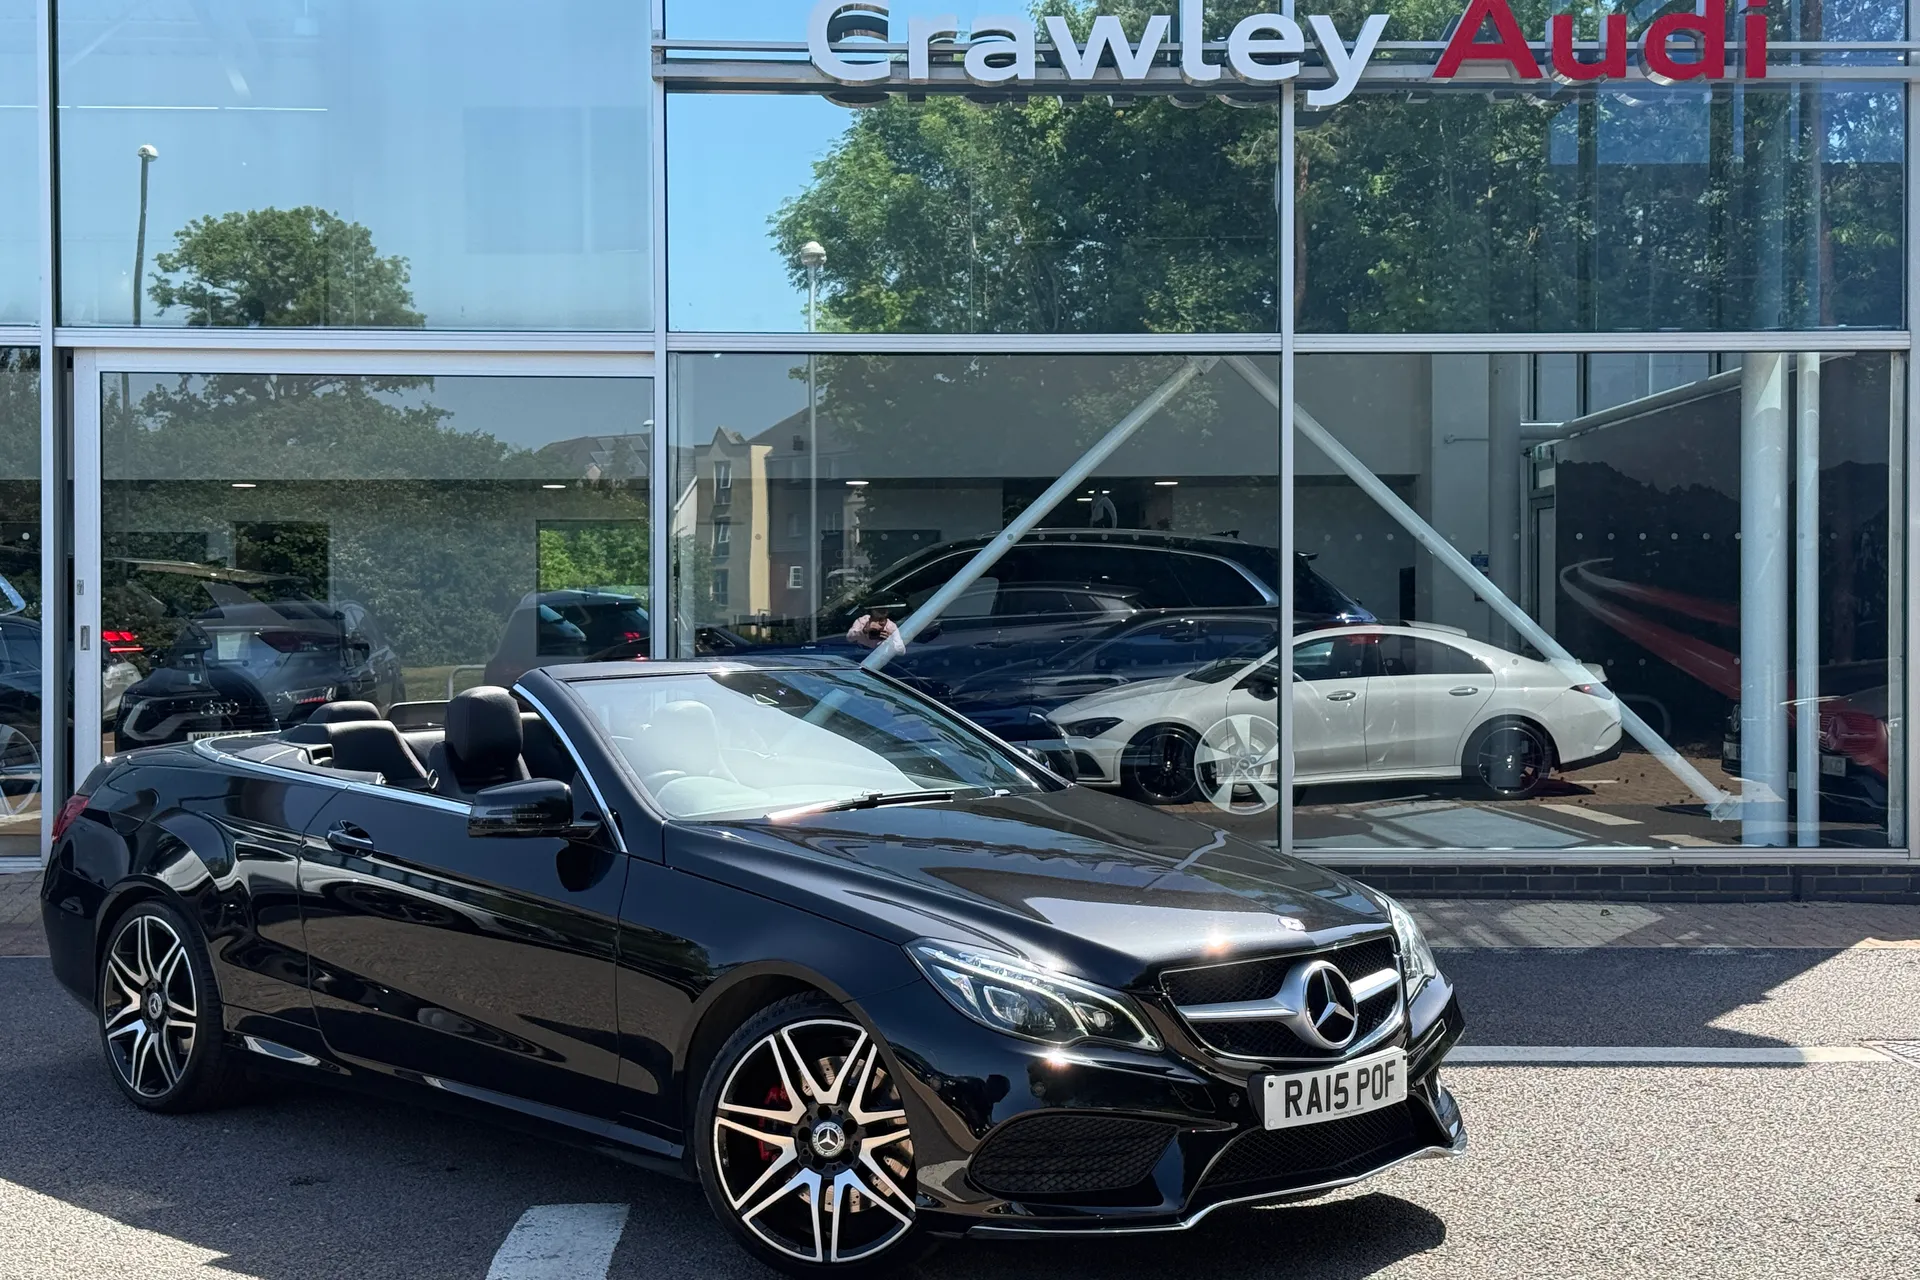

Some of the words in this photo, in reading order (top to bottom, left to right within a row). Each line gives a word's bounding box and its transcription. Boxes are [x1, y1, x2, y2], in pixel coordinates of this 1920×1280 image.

[807, 0, 1390, 107] Crawley
[1432, 0, 1767, 81] Audi
[1284, 1072, 1349, 1118] RA15
[1357, 1060, 1396, 1105] POF
